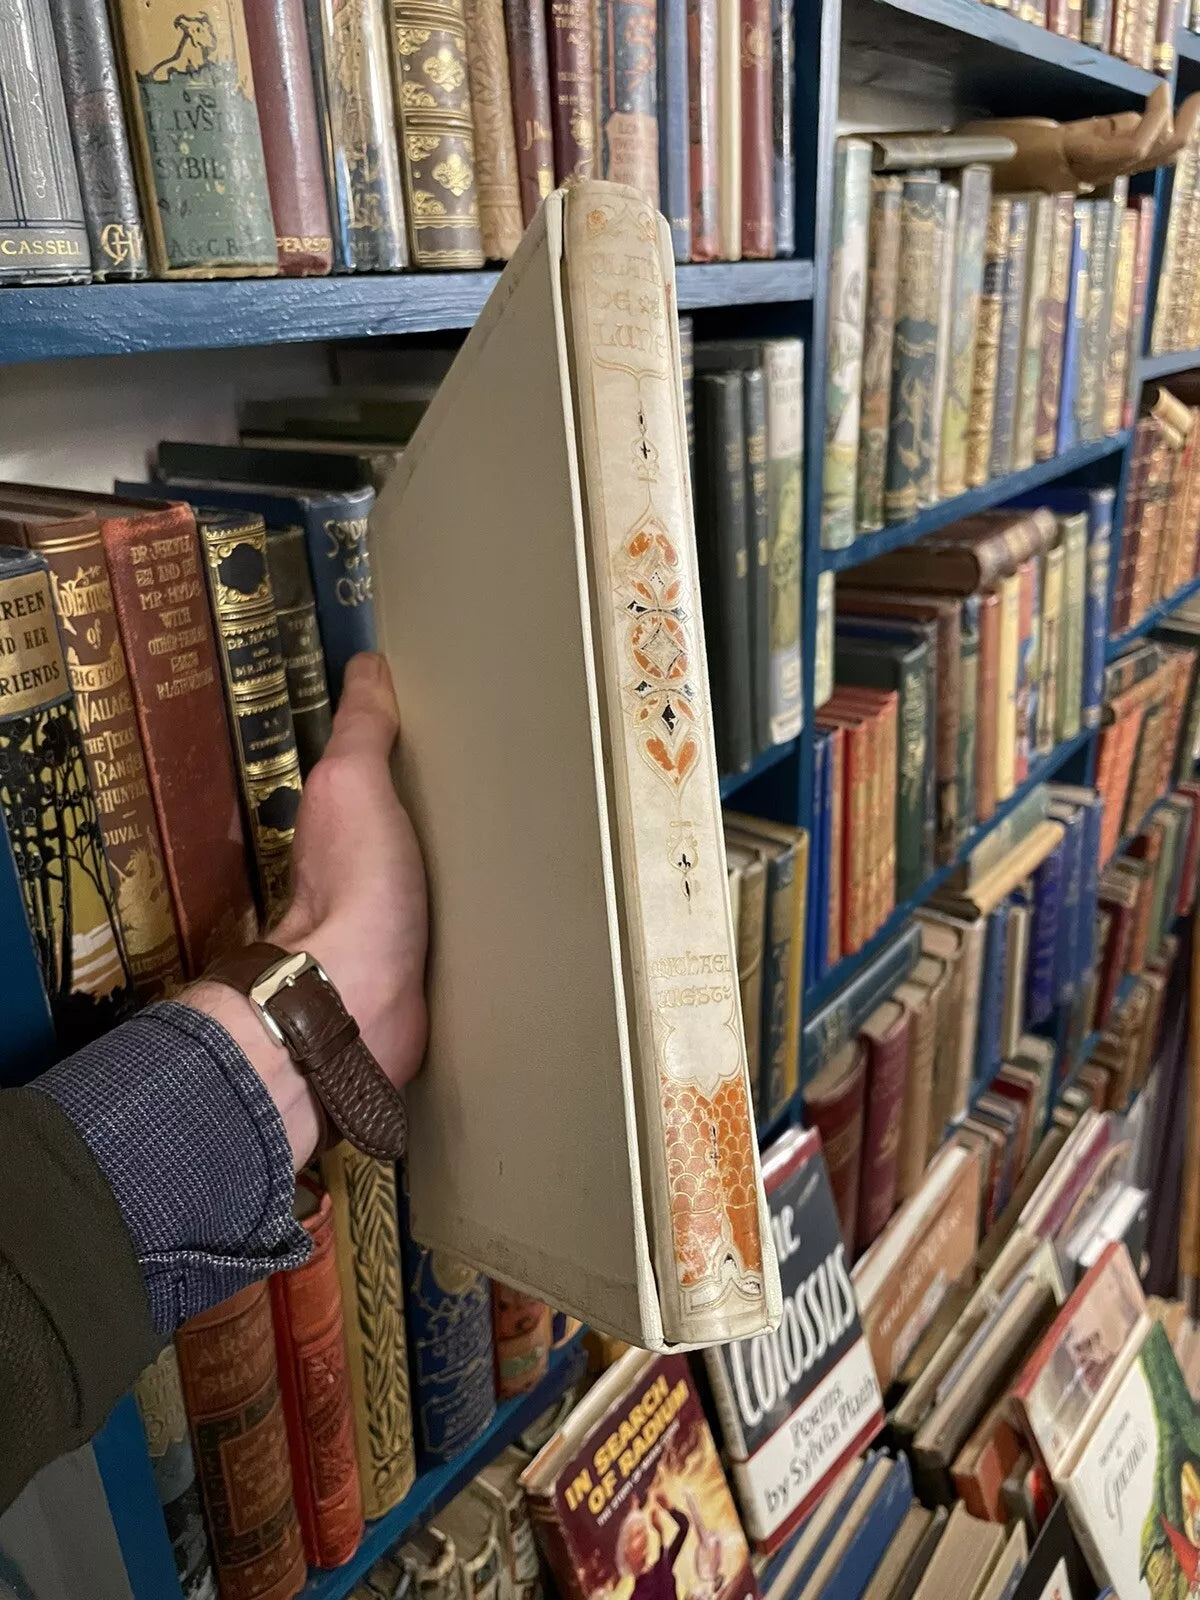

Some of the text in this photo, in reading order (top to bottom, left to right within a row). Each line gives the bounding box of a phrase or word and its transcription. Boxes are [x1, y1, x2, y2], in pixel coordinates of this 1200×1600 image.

[0, 590, 45, 620] REEN
[0, 661, 60, 697] RIENDS
[564, 1373, 669, 1512] IN SEARCH
[587, 1377, 690, 1515] OF RADIUM
[763, 1476, 791, 1513] by
